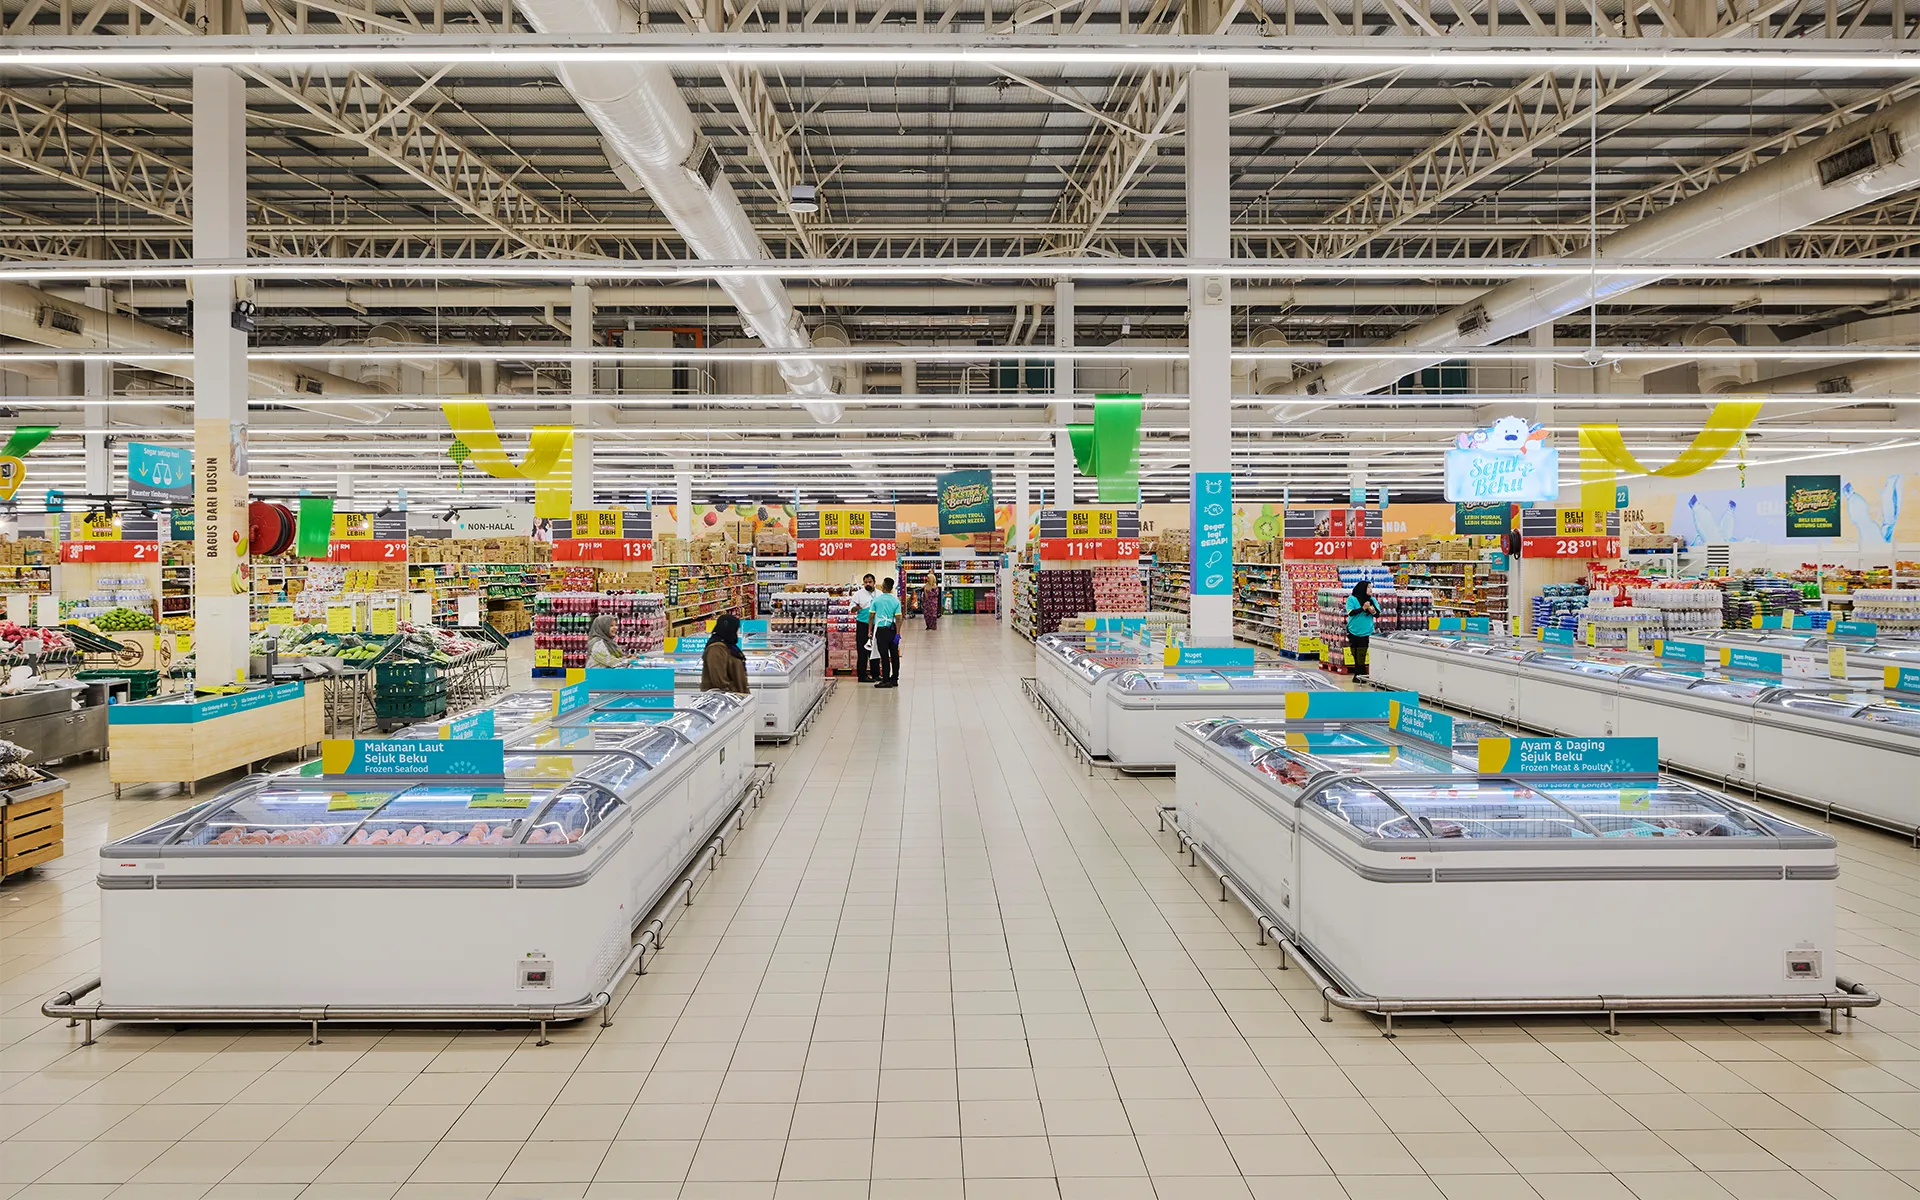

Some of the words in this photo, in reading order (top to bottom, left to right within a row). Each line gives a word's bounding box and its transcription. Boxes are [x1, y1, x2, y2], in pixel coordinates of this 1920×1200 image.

[1470, 455, 1534, 480] Sejuk
[206, 458, 218, 492] DUSUN
[1472, 476, 1524, 496] Beku
[1617, 492, 1626, 502] 22
[206, 497, 218, 521] DARI
[1624, 509, 1644, 522] BERAS
[206, 525, 218, 558] BAGUS
[1402, 706, 1413, 715] Ayam
[1418, 710, 1432, 723] Daging
[1402, 714, 1413, 725] Sejuk
[1414, 718, 1424, 728] Beku
[453, 721, 470, 732] Makanan
[470, 718, 478, 727] Laut
[364, 742, 416, 752] Makanan
[419, 742, 444, 752] Laut
[1520, 741, 1551, 752] Ayam
[1554, 741, 1563, 750] &
[1566, 740, 1605, 752] Daging
[364, 753, 396, 765] Sejuk
[399, 753, 427, 763] Beku
[1520, 752, 1551, 764] Sejuk
[1555, 752, 1583, 761] Beku
[1582, 763, 1612, 772] Poultry
